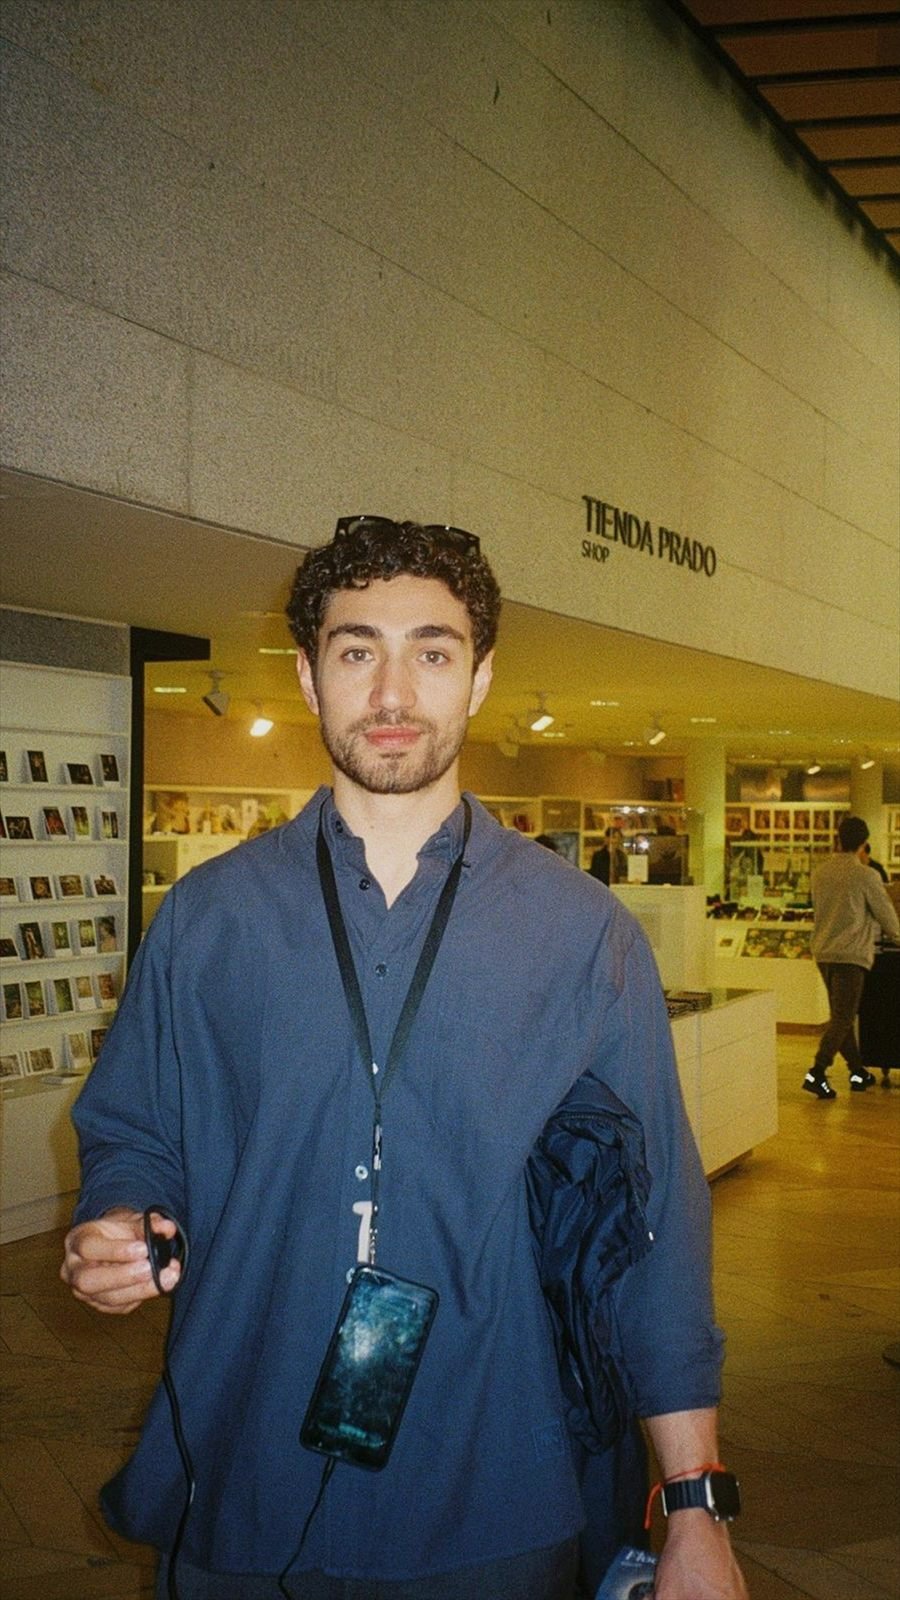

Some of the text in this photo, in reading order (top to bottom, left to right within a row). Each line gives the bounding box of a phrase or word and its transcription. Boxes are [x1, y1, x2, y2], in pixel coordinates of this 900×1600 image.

[582, 495, 716, 577] TIENDA PRADO
[582, 540, 610, 563] SHOP
